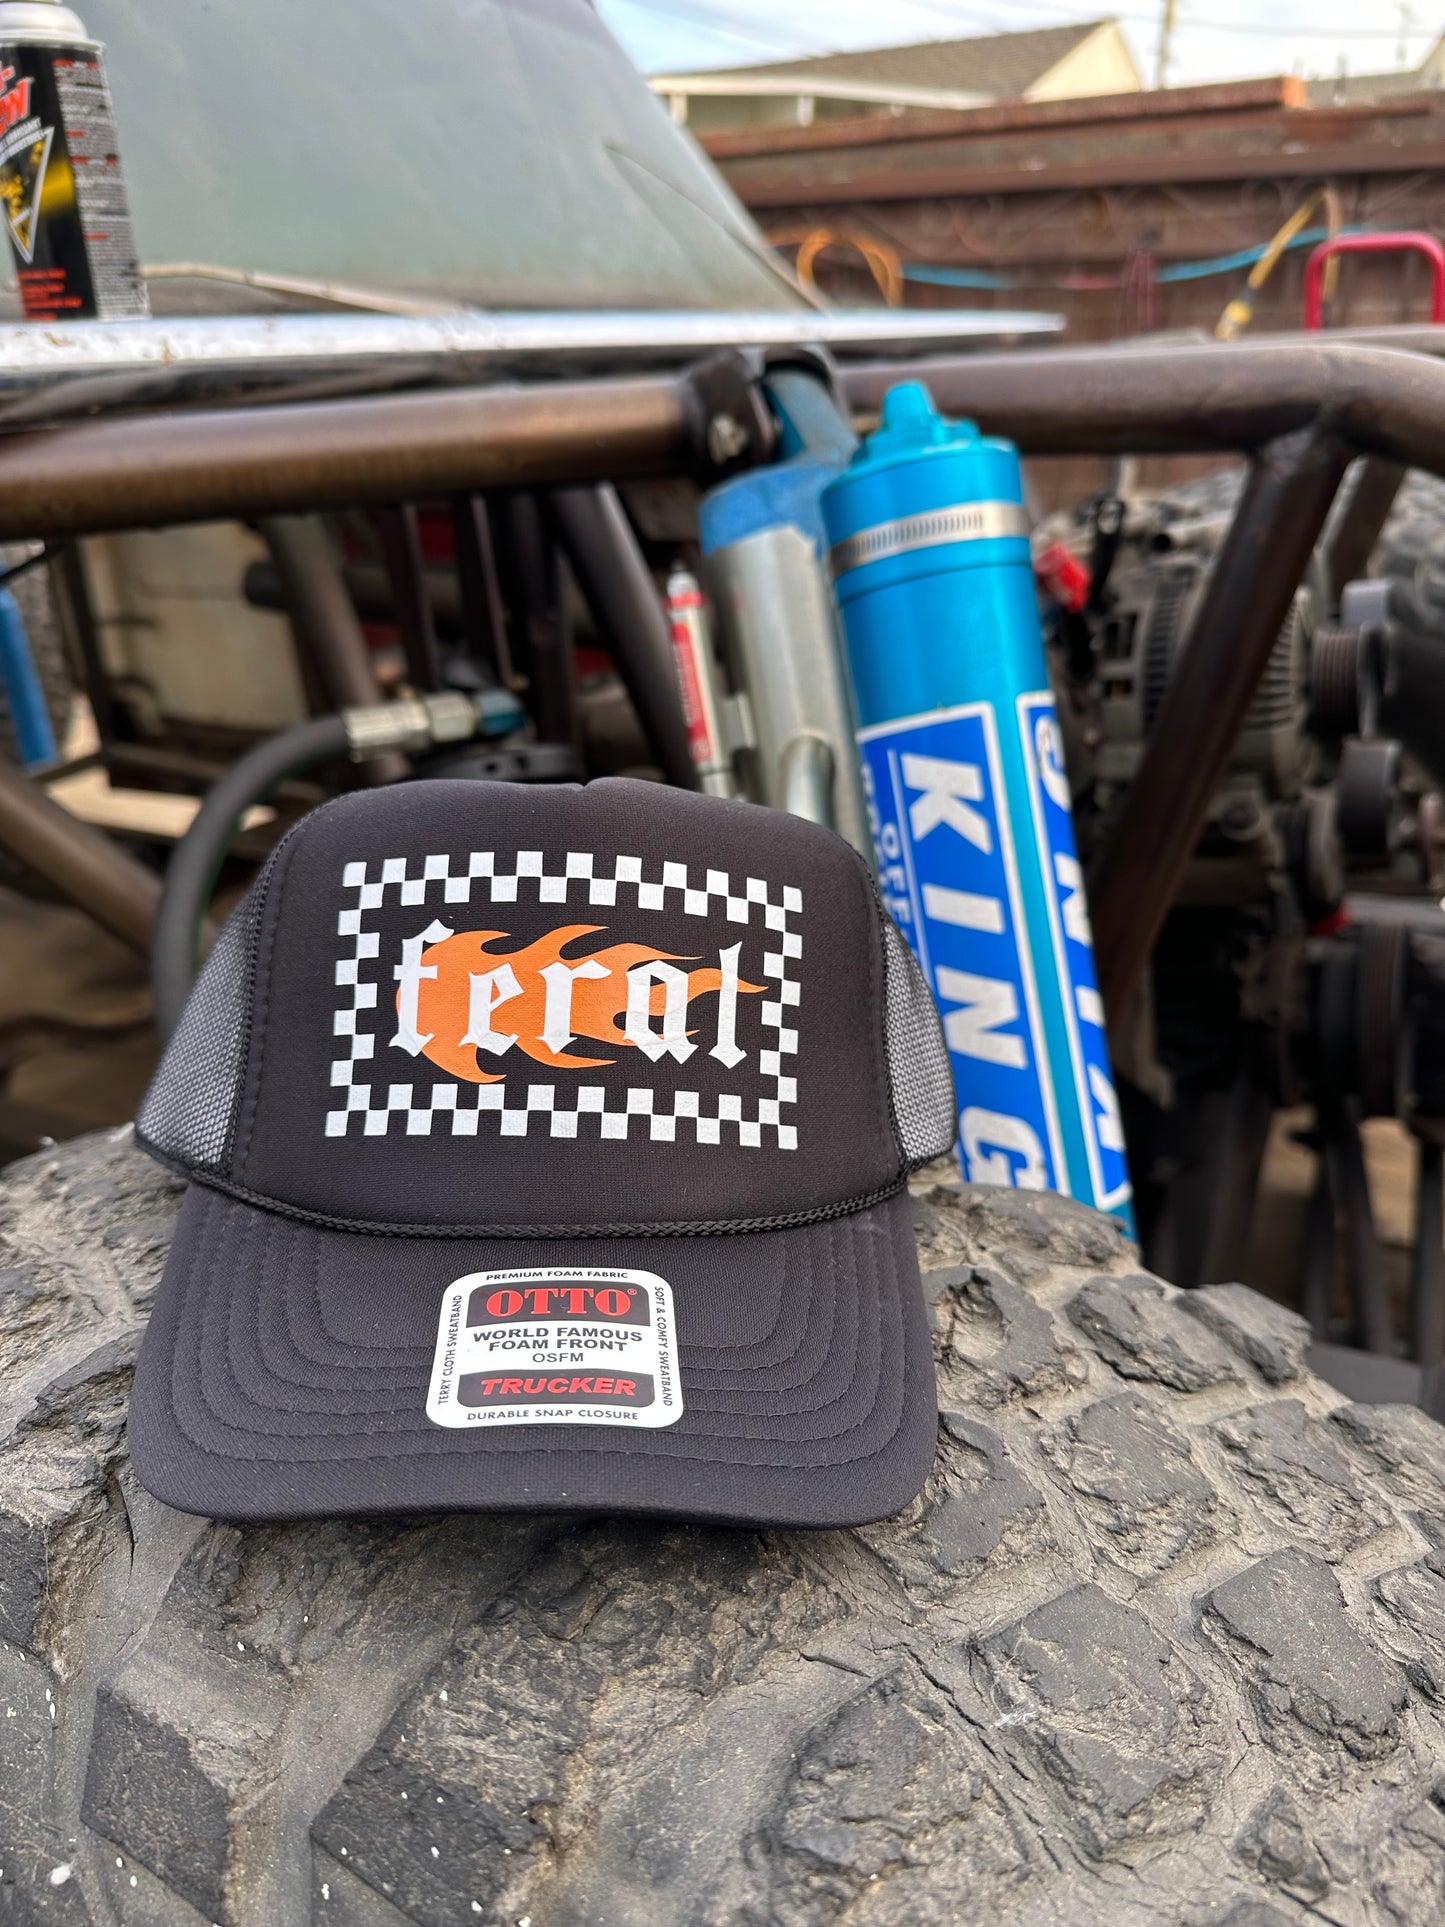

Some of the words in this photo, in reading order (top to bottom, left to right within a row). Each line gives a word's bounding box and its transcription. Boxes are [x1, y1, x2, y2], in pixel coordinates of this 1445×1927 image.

[901, 752, 1047, 1190] KING
[388, 918, 748, 1069] feral
[486, 1271, 543, 1281] PREMIUM
[654, 1286, 666, 1306] SOFT
[447, 1295, 462, 1347] SWEATBAND
[473, 1327, 549, 1342] WORLD
[556, 1328, 643, 1342] FAMOUS
[656, 1317, 668, 1349] COMFY
[489, 1340, 549, 1351] FOAM
[556, 1339, 627, 1351] FRONT
[442, 1349, 456, 1377] CLOTH
[532, 1352, 584, 1363] OSFM
[481, 1378, 637, 1396] TRUCKER
[659, 1351, 673, 1406] SWEATBAND
[438, 1379, 452, 1405] TERRY
[467, 1410, 530, 1420] DURABLE
[535, 1409, 573, 1417] SNAP
[578, 1409, 638, 1420] CLOSURE
